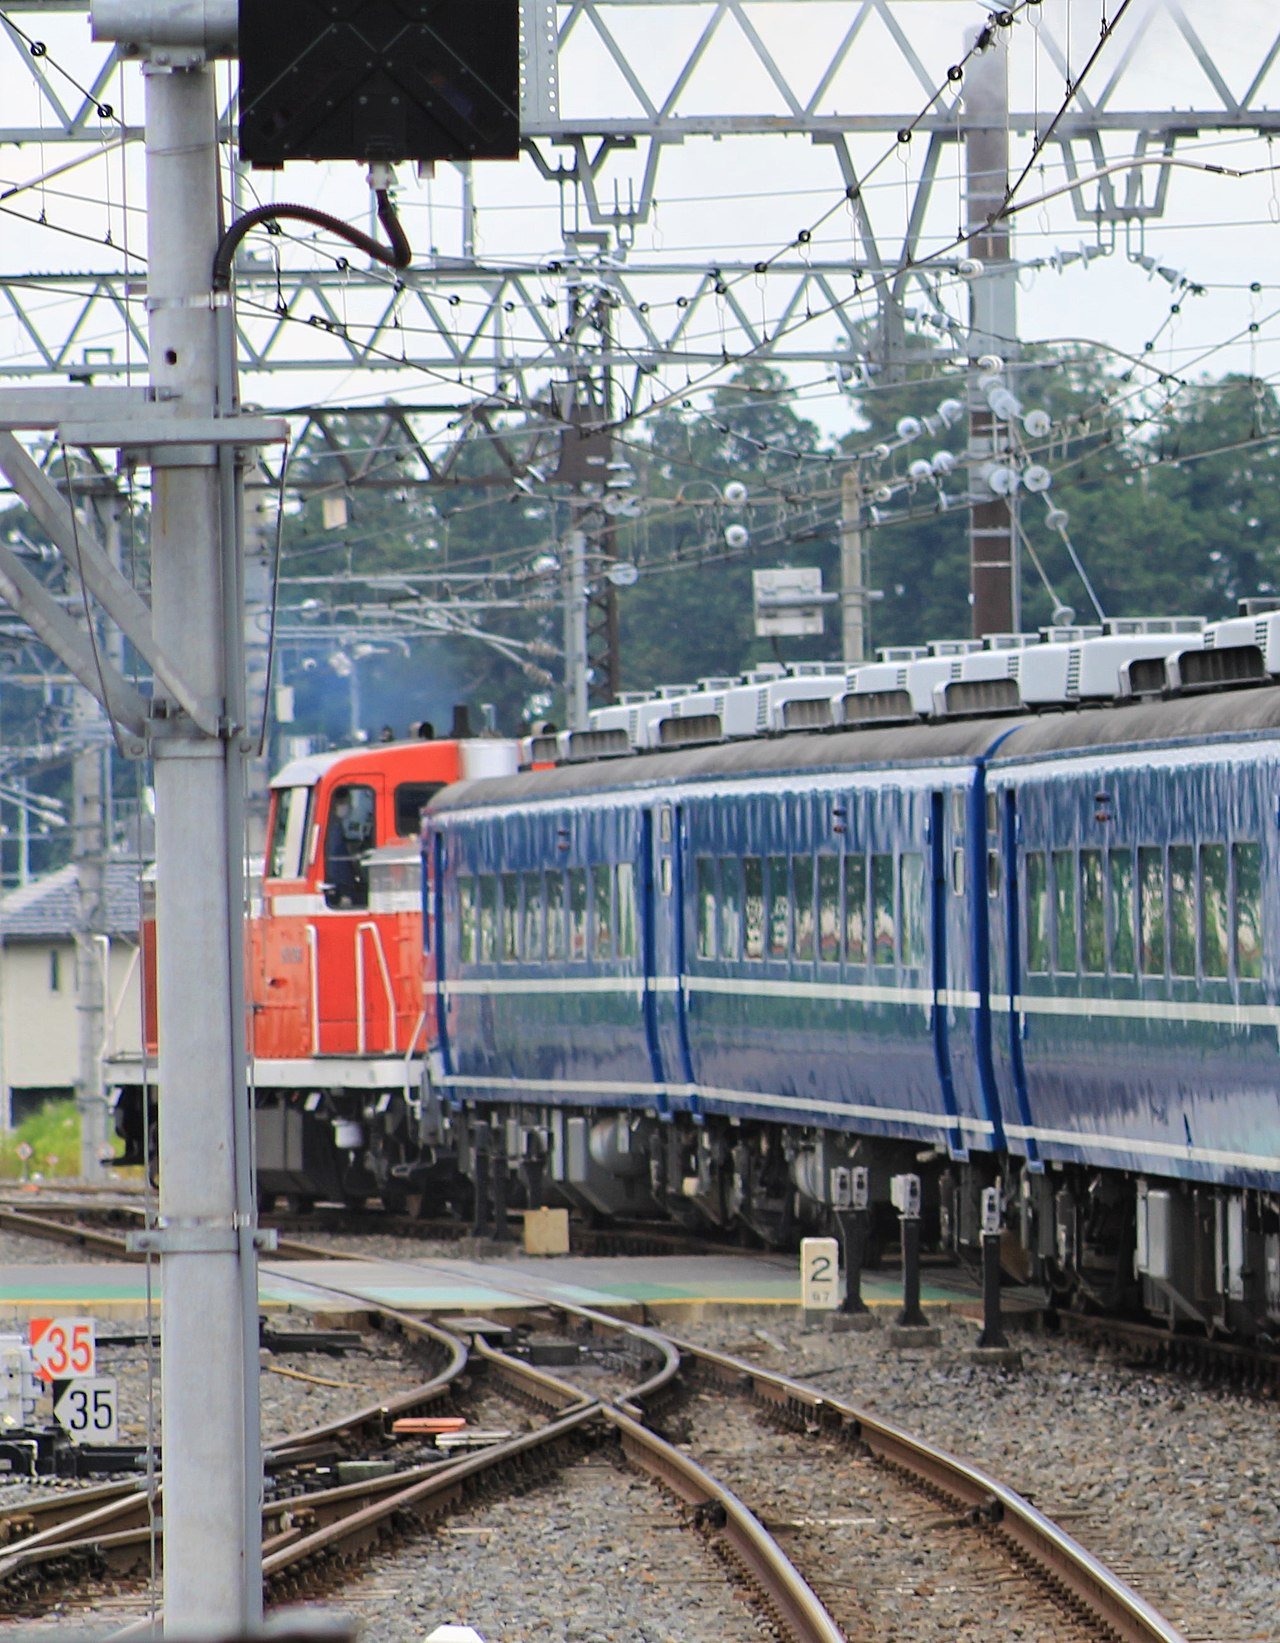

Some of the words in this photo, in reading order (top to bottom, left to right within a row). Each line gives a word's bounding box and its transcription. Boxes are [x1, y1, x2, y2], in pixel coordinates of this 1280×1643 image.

[811, 1256, 833, 1281] 2
[47, 1326, 91, 1374] 35
[69, 1390, 113, 1430] 35
